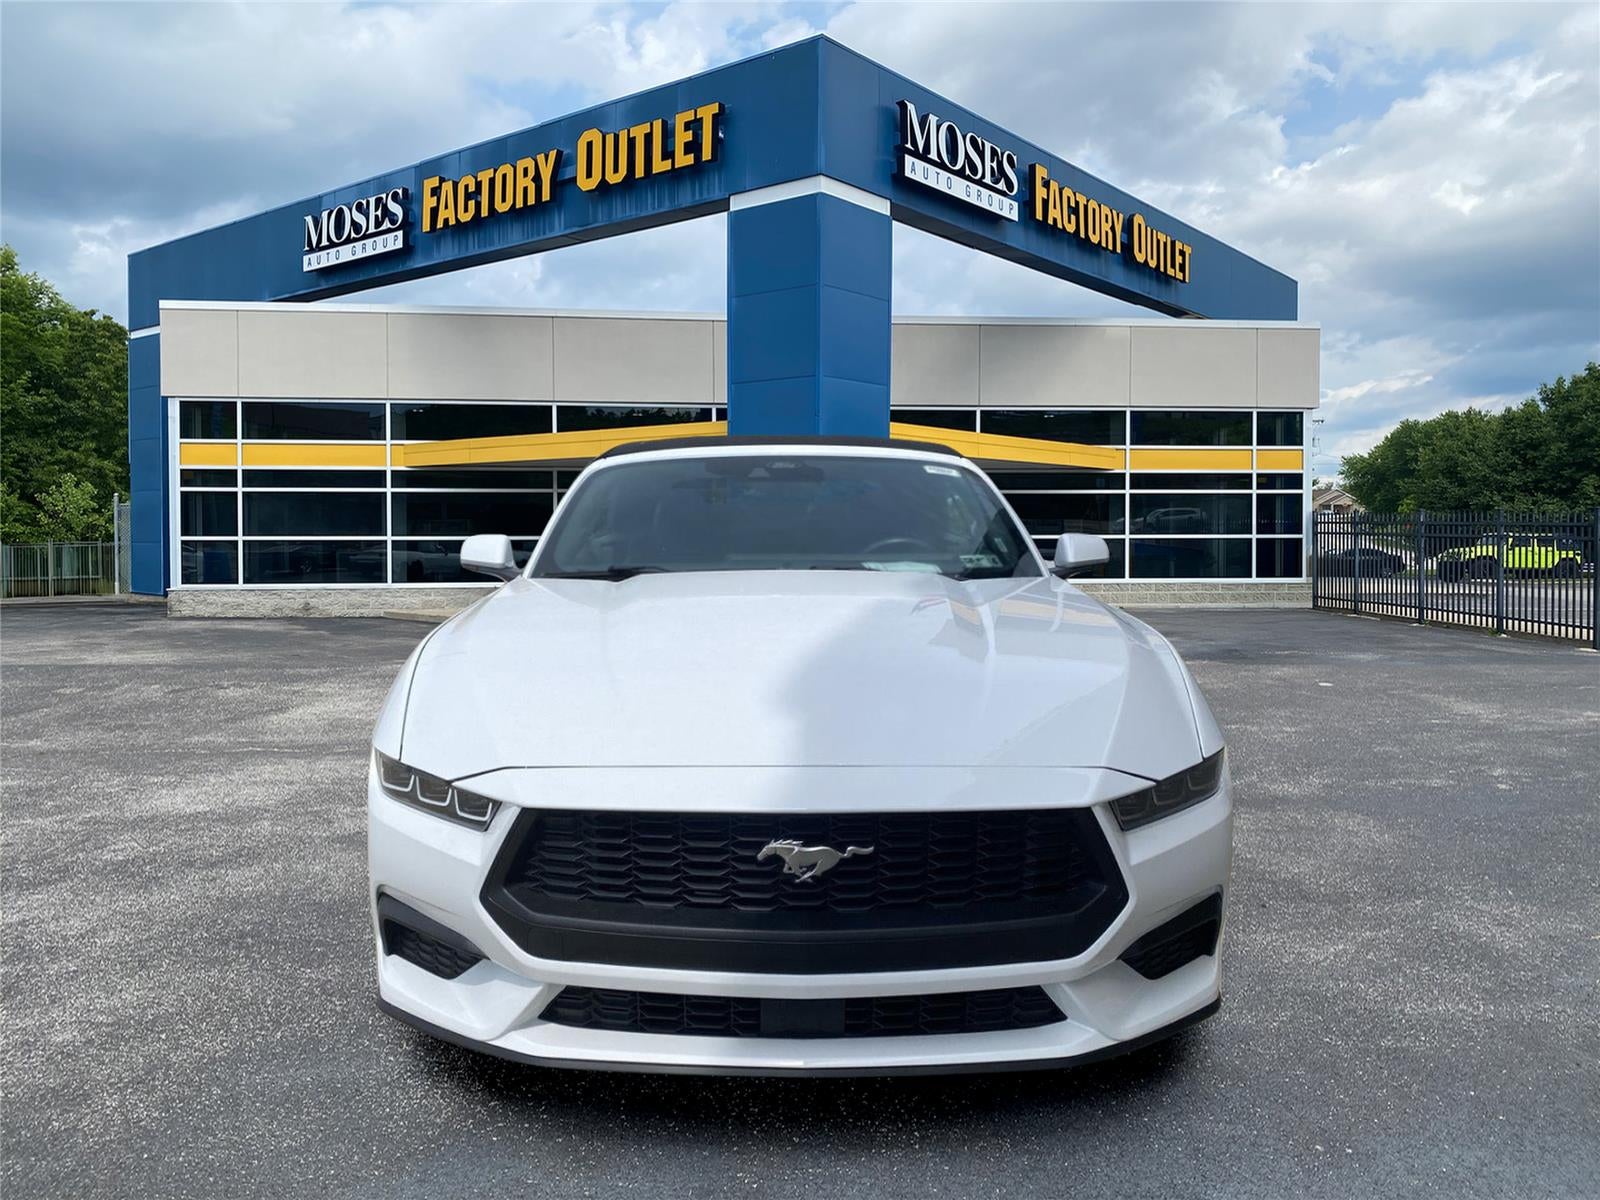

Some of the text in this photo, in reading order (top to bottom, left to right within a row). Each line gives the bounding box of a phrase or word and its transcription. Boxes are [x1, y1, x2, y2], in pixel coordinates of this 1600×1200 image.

[422, 102, 721, 232] FACTORY OUTLET
[904, 100, 1018, 196] MOSES
[910, 161, 1015, 214] AUTO GROUP
[303, 188, 403, 251] MOSES
[307, 234, 399, 268] AUTO GROUP
[1035, 164, 1191, 283] FACTORY OUTLET
